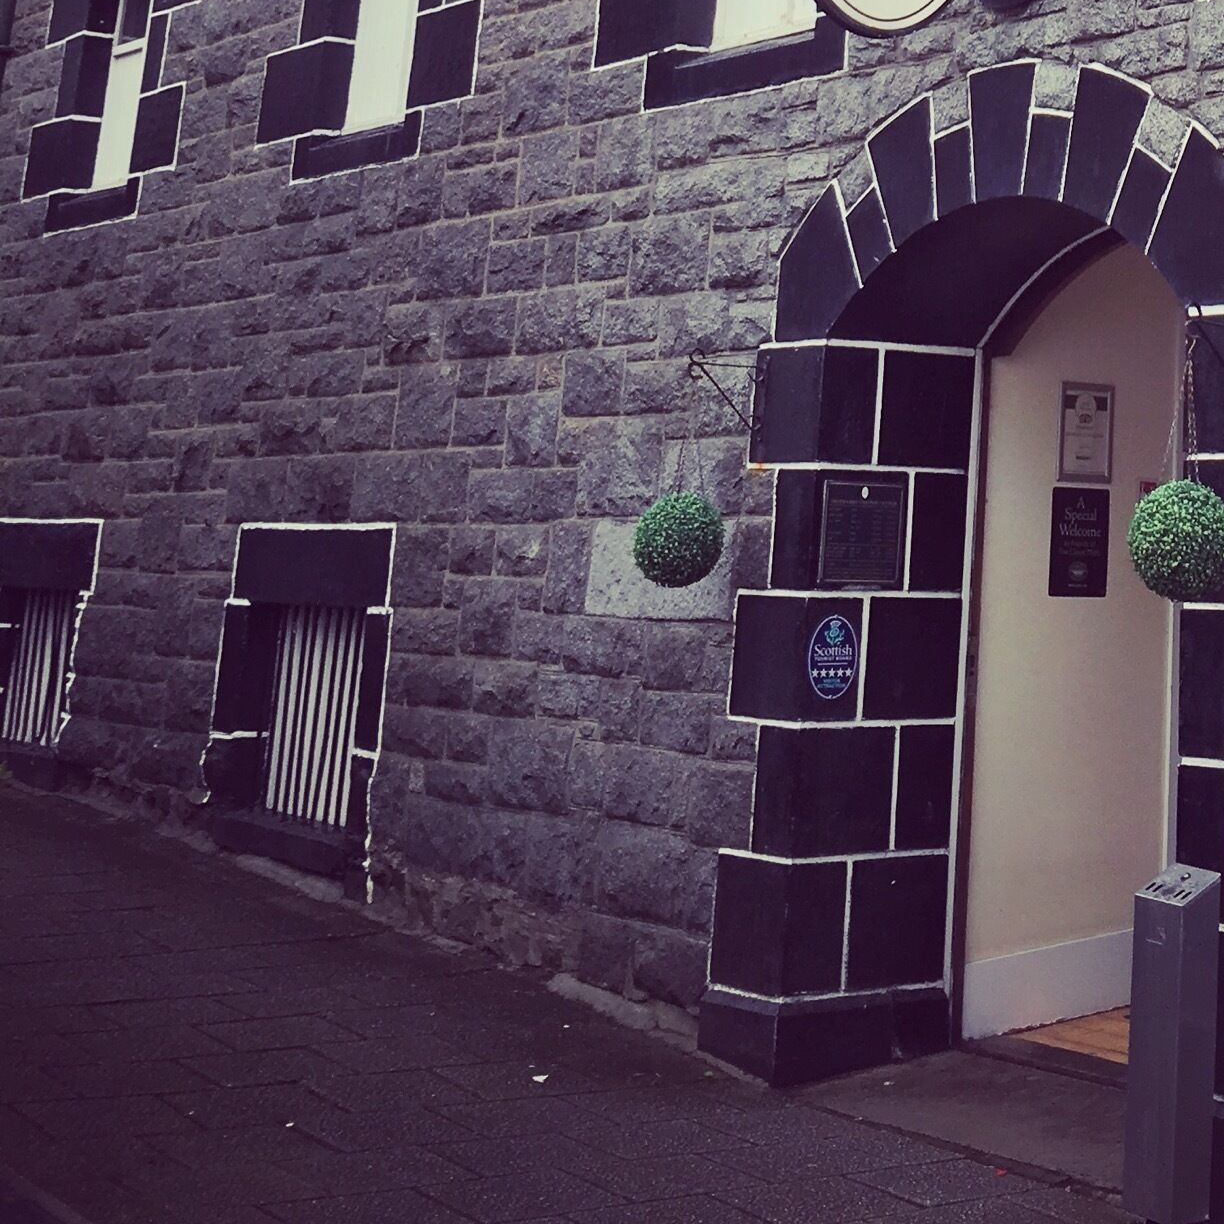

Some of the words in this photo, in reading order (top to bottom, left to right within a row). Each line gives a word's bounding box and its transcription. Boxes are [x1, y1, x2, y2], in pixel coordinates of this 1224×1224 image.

[1064, 507, 1098, 525] Special
[1059, 523, 1102, 537] Welcome
[813, 643, 853, 657] Scottish
